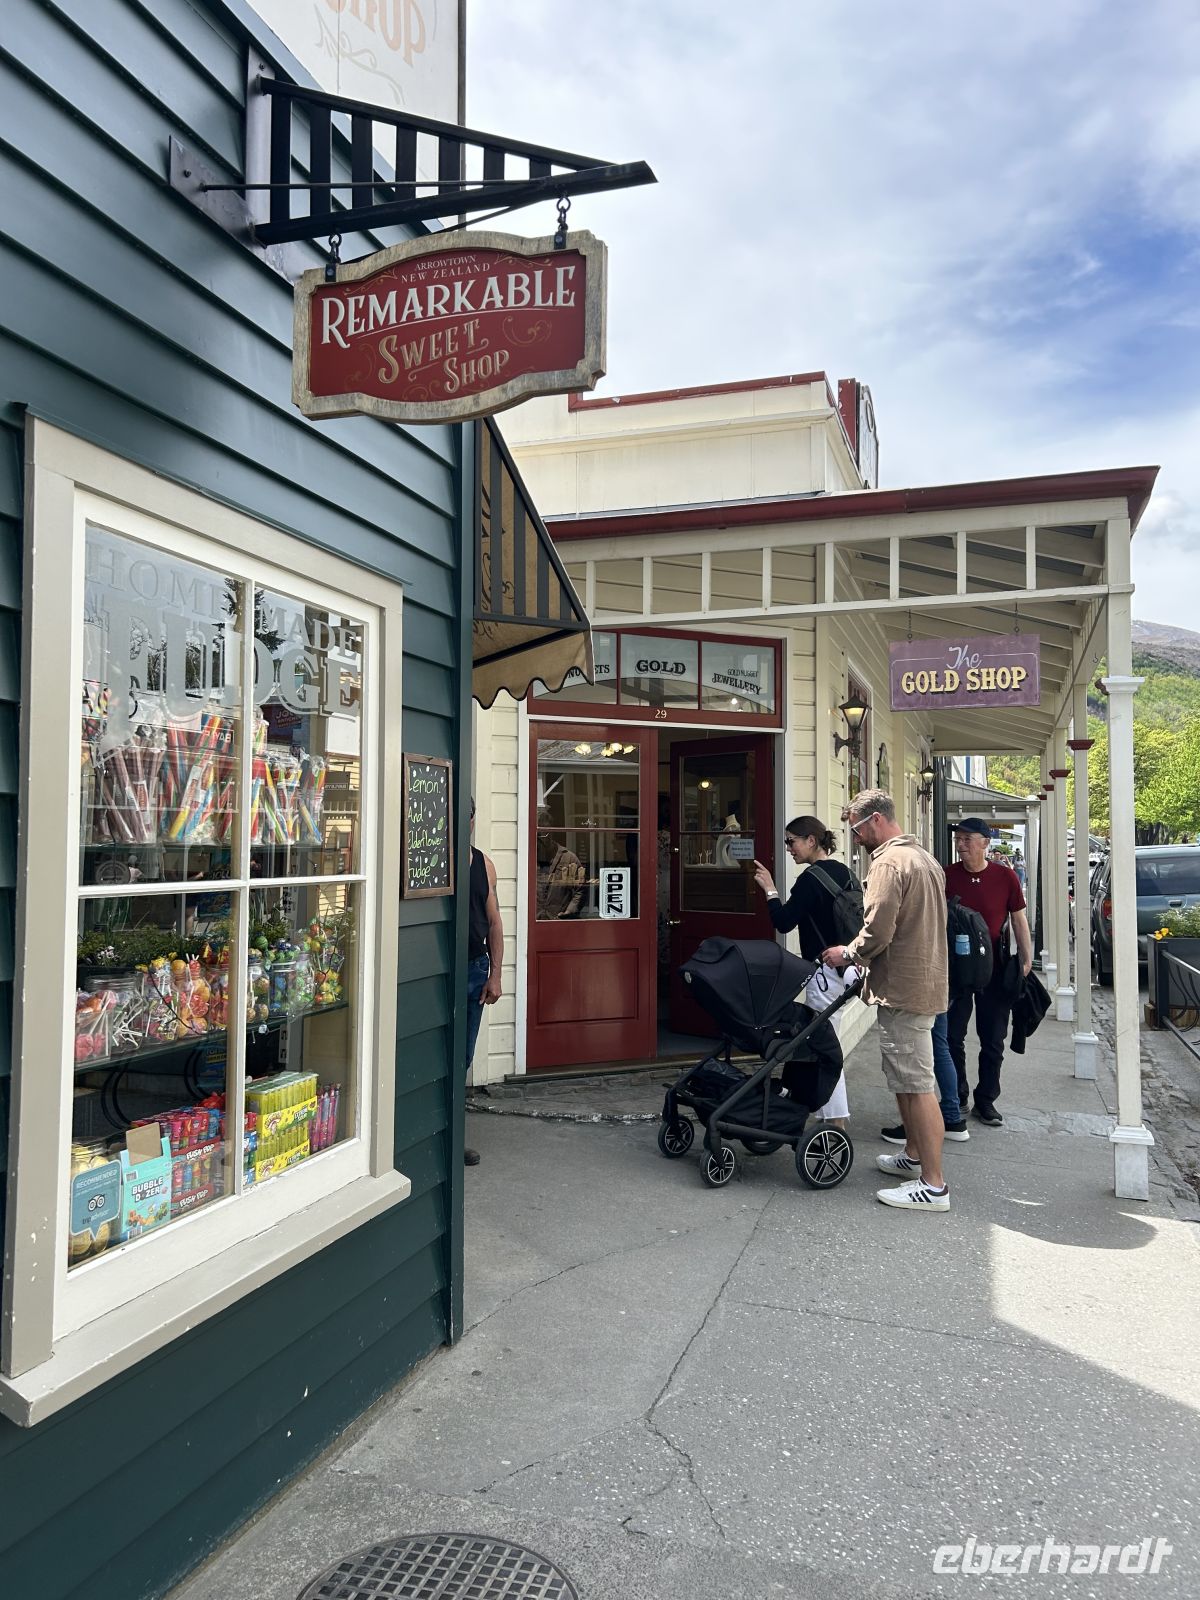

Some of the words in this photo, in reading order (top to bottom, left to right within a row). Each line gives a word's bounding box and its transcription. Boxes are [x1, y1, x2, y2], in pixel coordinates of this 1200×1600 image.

[401, 271, 428, 284] NEW
[433, 262, 491, 280] ZEALAND
[414, 254, 478, 272] ARROWTOWN
[321, 265, 576, 349] REMARKABLE
[378, 318, 489, 385] SWEET
[444, 349, 510, 394] SHOP
[256, 602, 357, 662] MADE
[635, 659, 687, 676] GOLD
[946, 644, 983, 671] The
[712, 672, 763, 696] JEWELLERY
[901, 669, 961, 695] GOLD
[966, 666, 1028, 693] SHOP
[654, 709, 668, 720] 29
[408, 829, 444, 850] Elderflower
[408, 856, 431, 885] Fudge
[607, 873, 623, 914] OPEN
[186, 1147, 203, 1161] PUSH
[203, 1143, 215, 1155] POP
[76, 1168, 117, 1189] RECOMMENDED
[132, 1176, 163, 1195] BUBBLE
